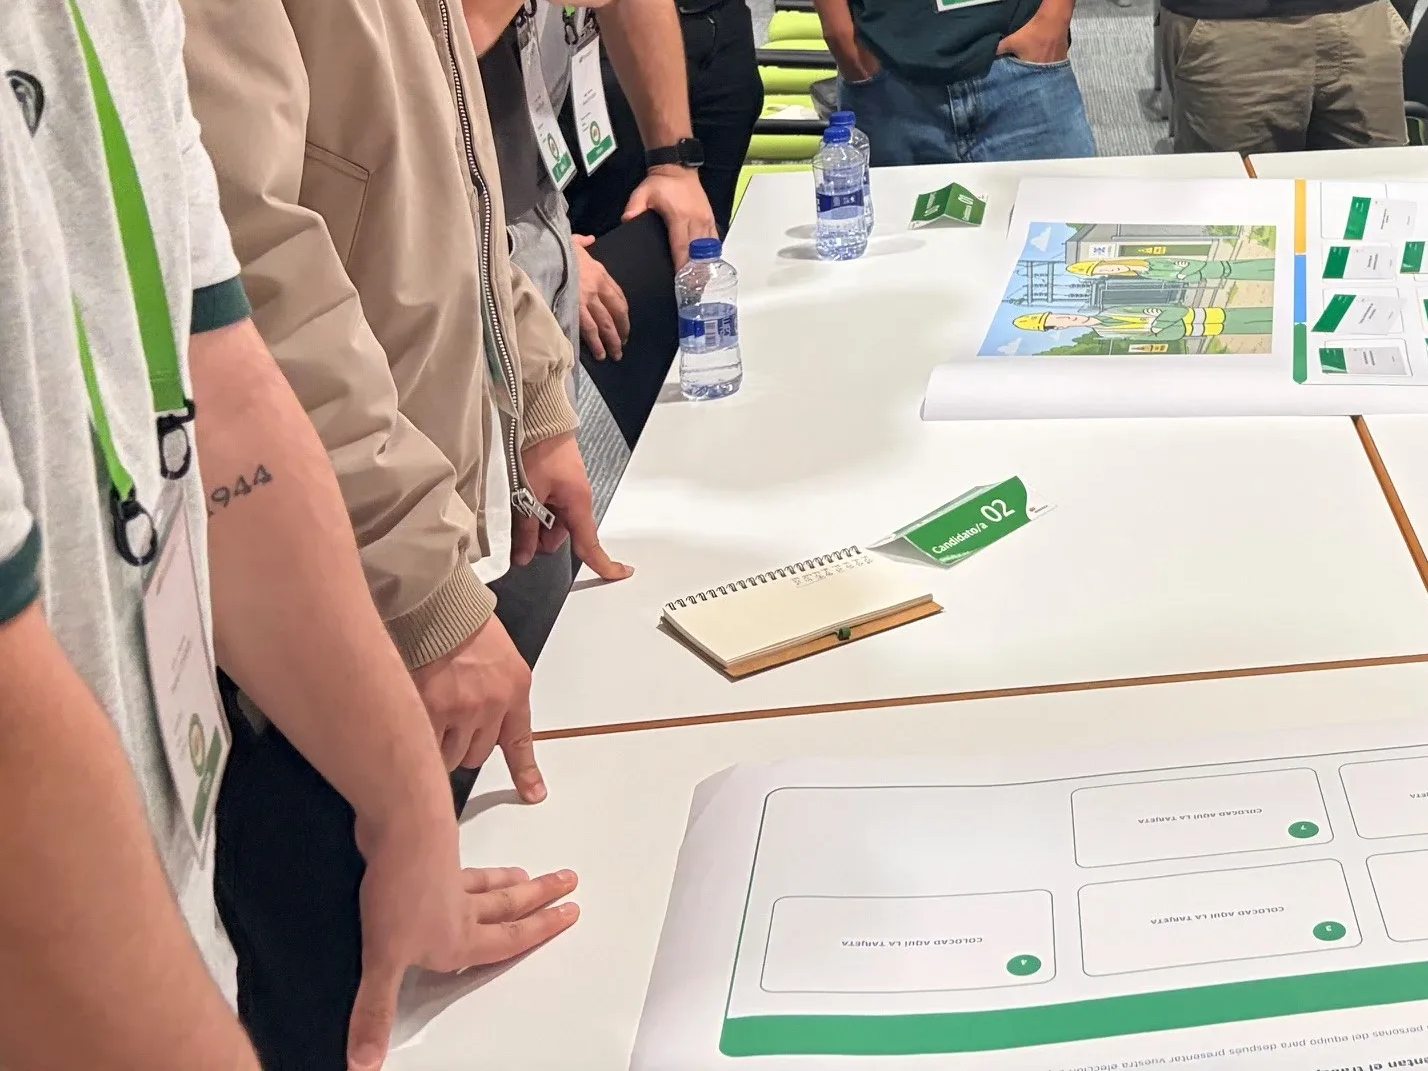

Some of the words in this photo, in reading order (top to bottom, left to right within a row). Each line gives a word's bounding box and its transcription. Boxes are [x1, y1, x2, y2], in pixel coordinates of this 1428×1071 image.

[206, 464, 273, 517] 944
[932, 520, 988, 554] Candidato/a
[980, 498, 1016, 523] 02
[1194, 812, 1216, 820] AQUÍ
[1219, 808, 1262, 817] COLOCAD
[1138, 816, 1177, 824] TARJETA
[1210, 911, 1234, 919] AQUÍ
[1238, 906, 1284, 916] COLOCAD
[1150, 915, 1192, 925] TARJETA
[905, 939, 930, 947] AQUÍ
[934, 937, 983, 946] COLOCAD
[1372, 1024, 1424, 1039] personas
[1309, 1034, 1349, 1047] equipo
[1351, 1033, 1369, 1043] del
[1281, 1038, 1305, 1049] para
[1229, 1042, 1276, 1056] después
[1169, 1049, 1225, 1063] presentar
[1122, 1058, 1165, 1068] vuestra
